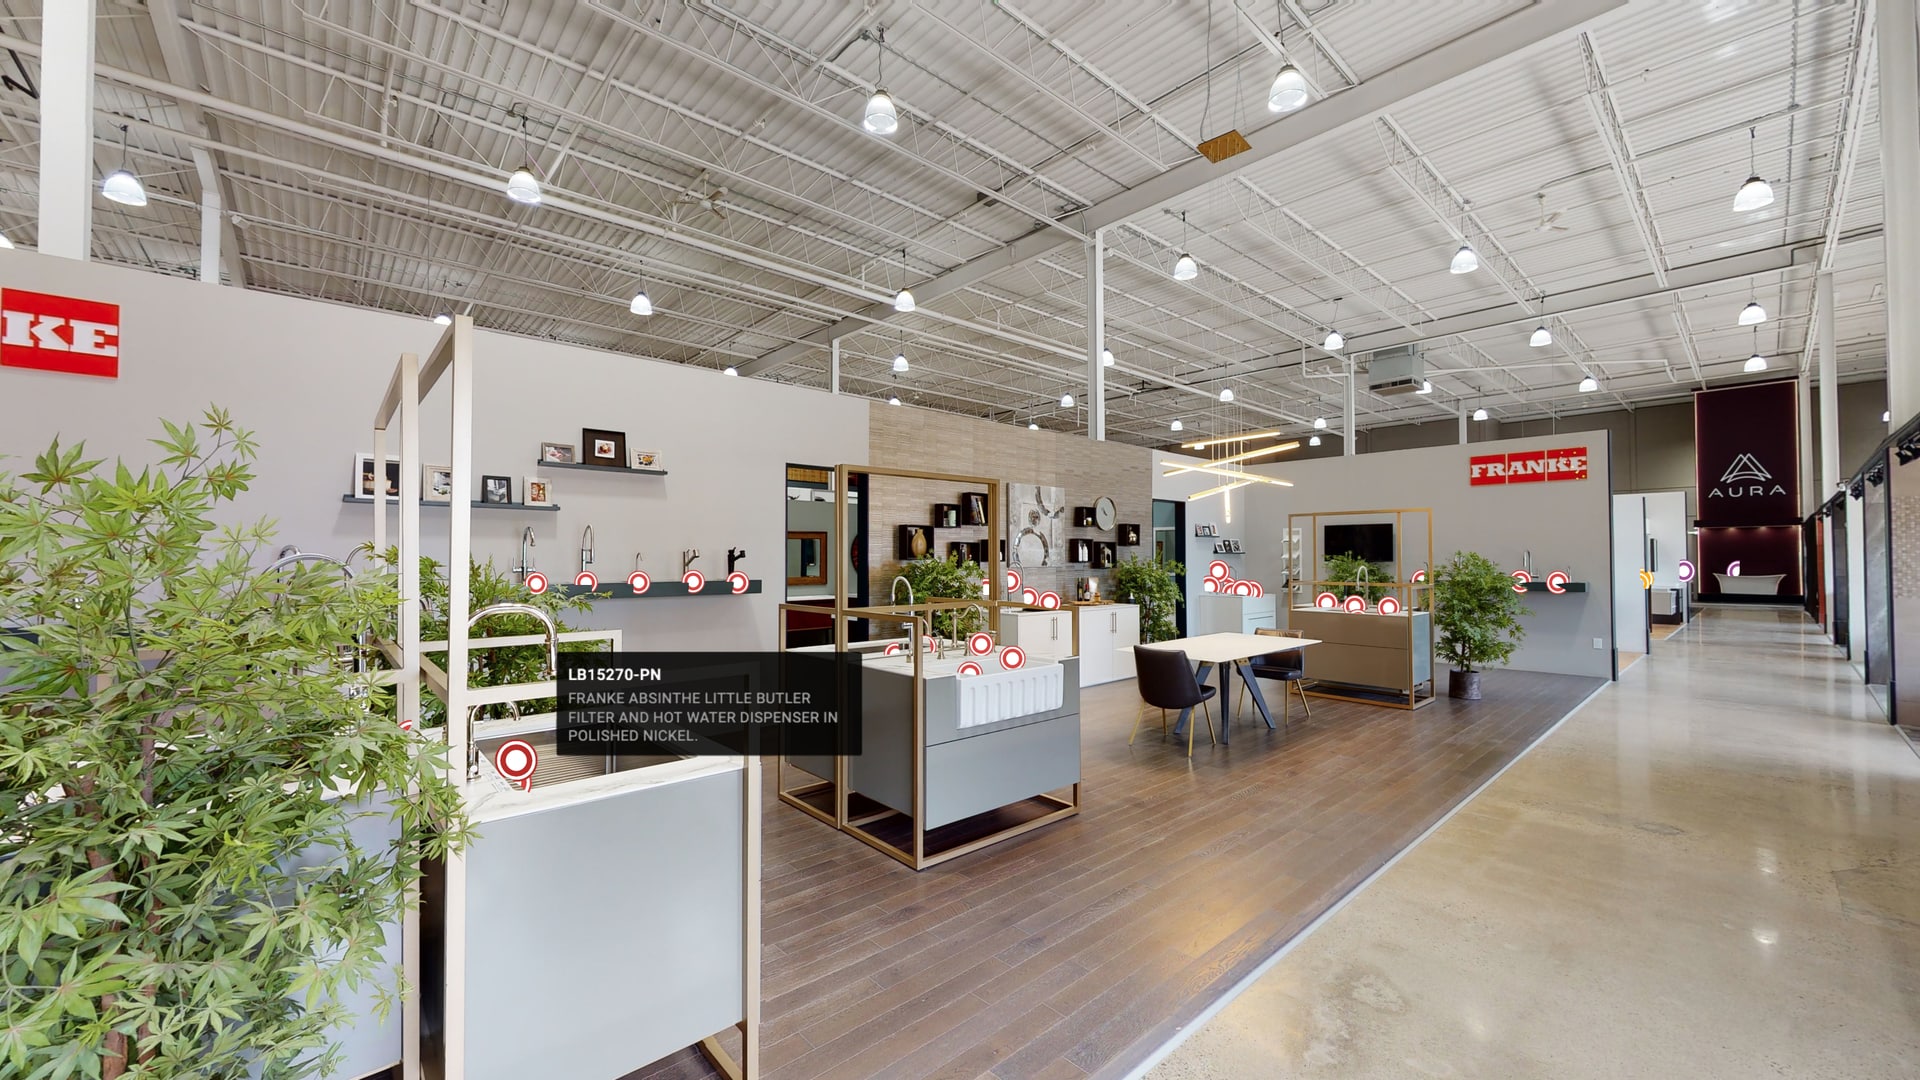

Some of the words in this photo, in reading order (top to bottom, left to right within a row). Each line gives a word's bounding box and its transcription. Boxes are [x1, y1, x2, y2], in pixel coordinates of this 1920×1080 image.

[2, 310, 118, 358] KE
[1470, 455, 1587, 479] FRANKE
[1708, 484, 1787, 499] AURA
